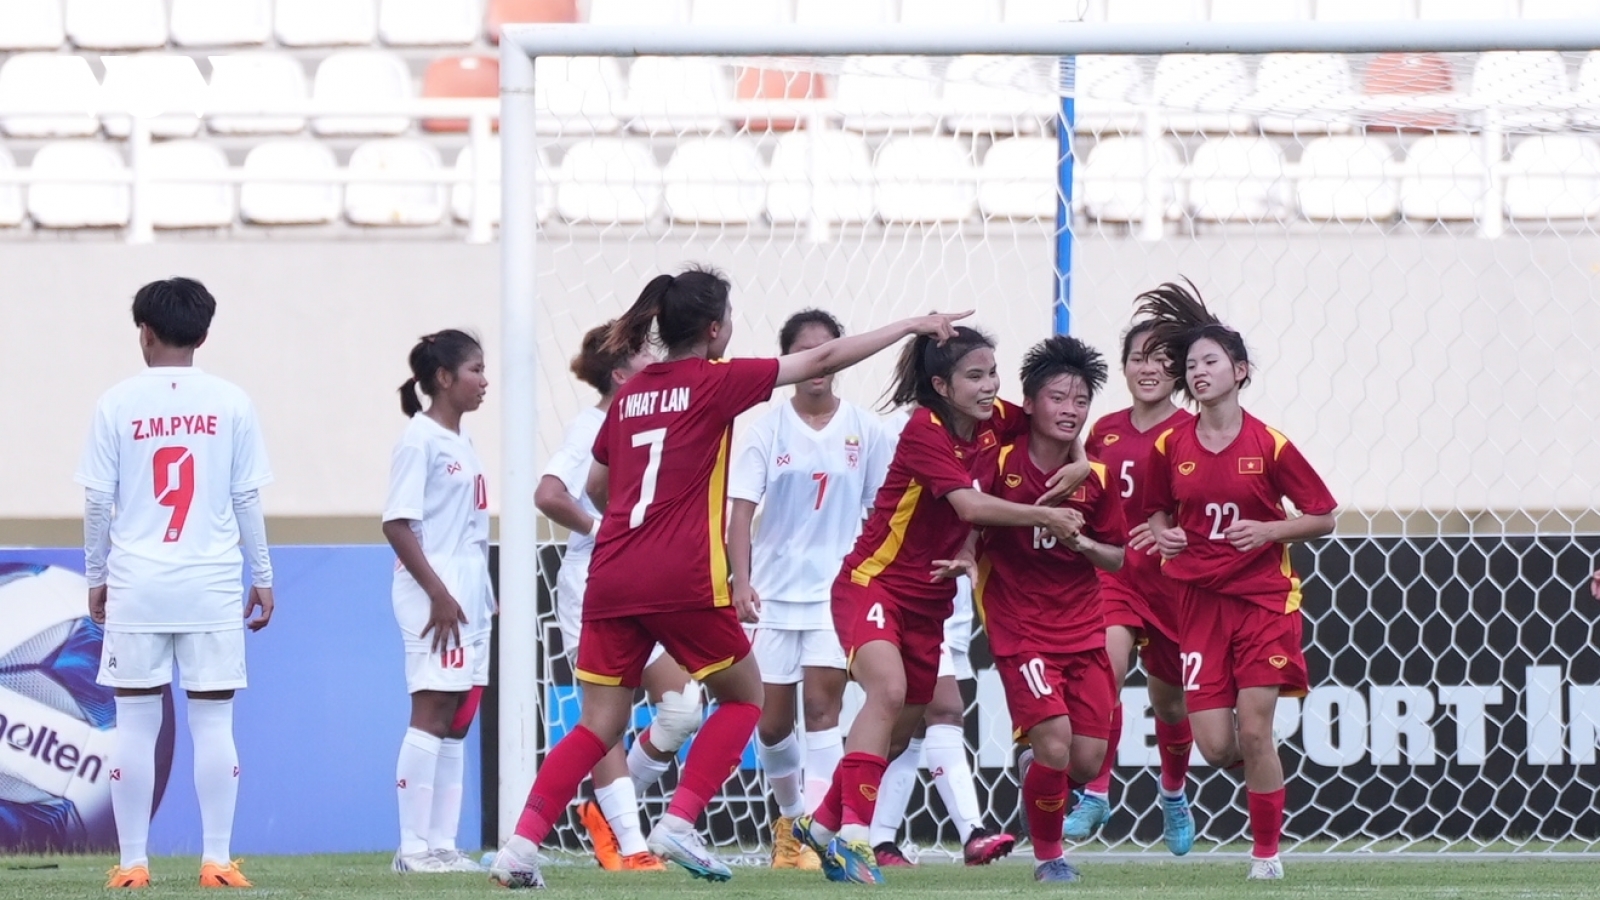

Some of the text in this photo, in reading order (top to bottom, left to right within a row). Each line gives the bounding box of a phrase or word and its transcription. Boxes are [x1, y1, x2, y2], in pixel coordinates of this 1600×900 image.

[660, 387, 690, 413] LAN
[131, 415, 217, 440] Z.M.PYAE
[153, 446, 194, 542] 9
[629, 427, 667, 529] 7
[812, 472, 828, 510] 7
[1120, 460, 1135, 498] 5
[1205, 502, 1240, 540] 22
[866, 602, 886, 629] 4
[1019, 657, 1053, 699] 10
